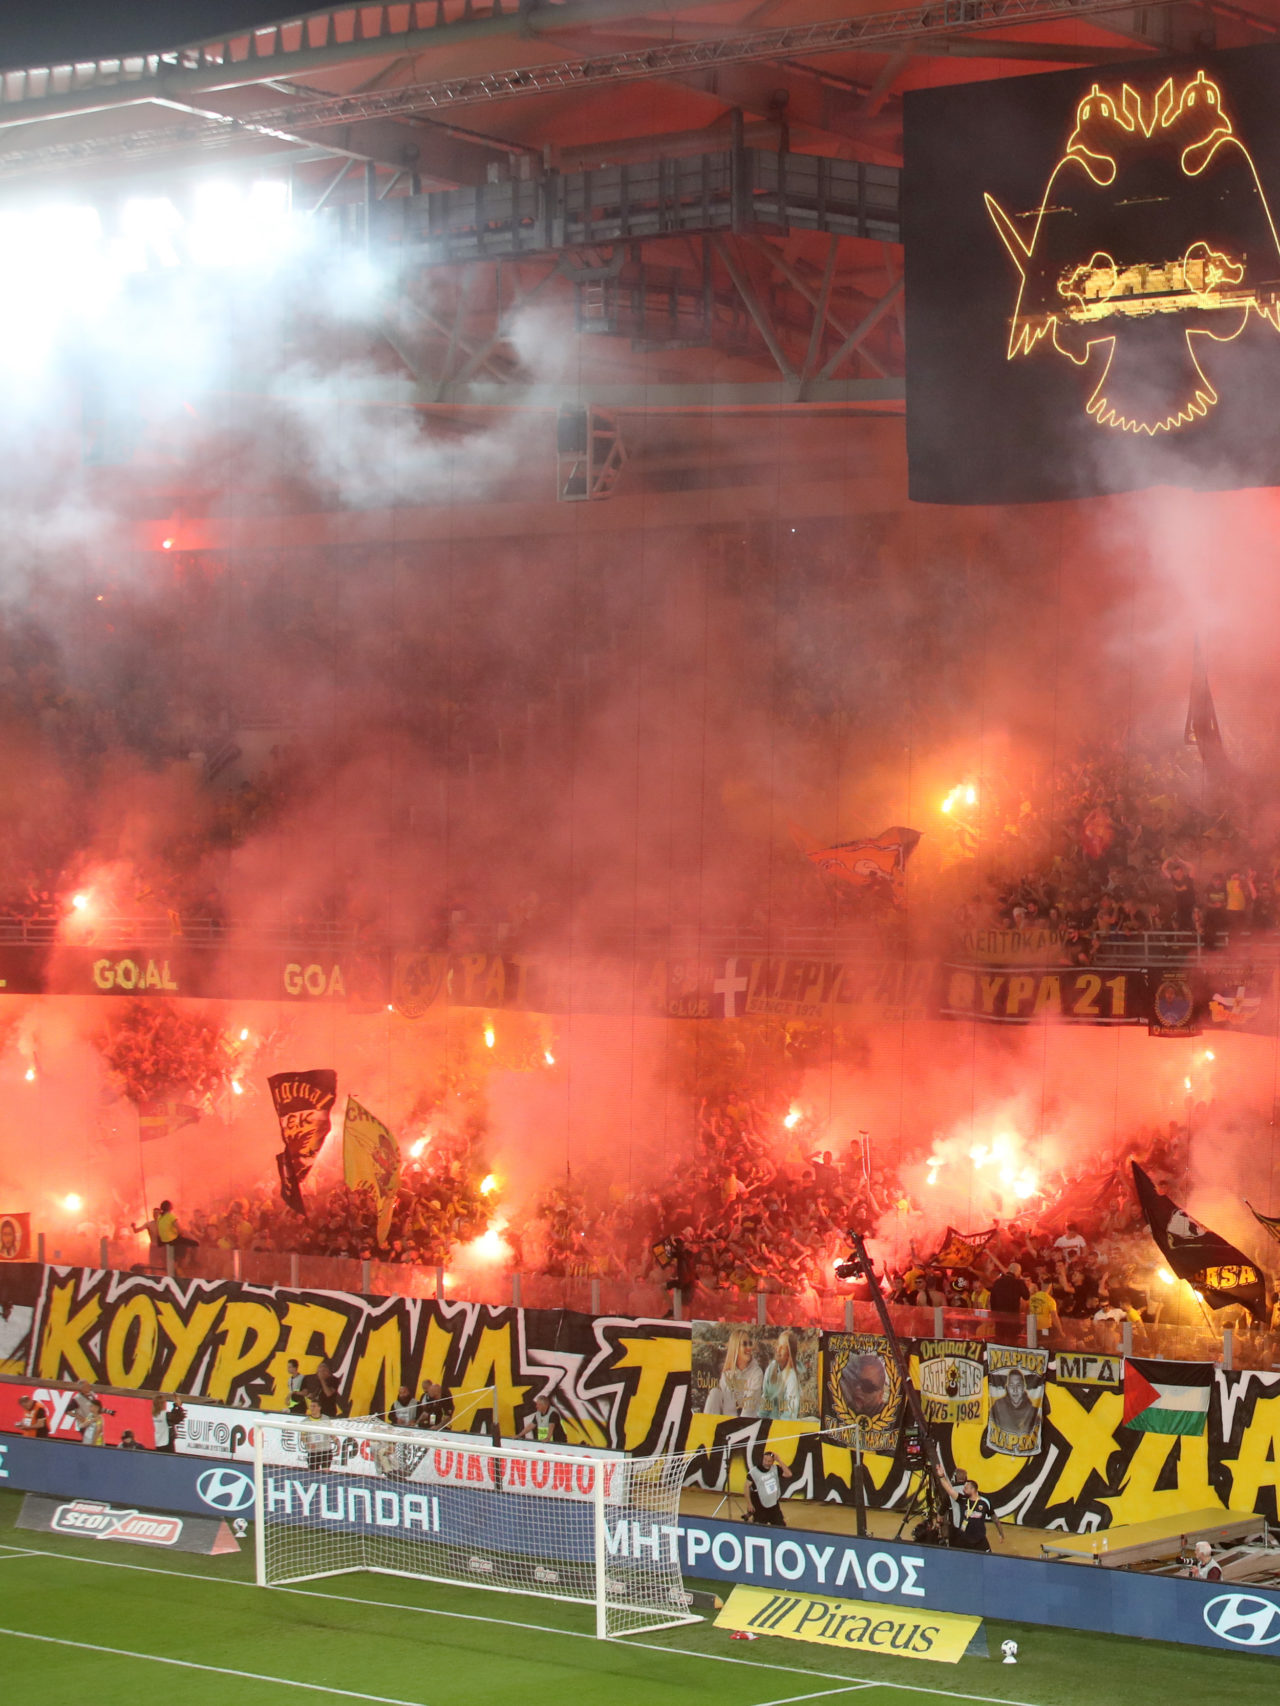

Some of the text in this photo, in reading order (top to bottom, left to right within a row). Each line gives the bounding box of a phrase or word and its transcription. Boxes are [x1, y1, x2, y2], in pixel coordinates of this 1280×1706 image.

[93, 958, 178, 990] GOAL
[284, 964, 346, 995] GOA
[1073, 974, 1126, 1016] 21
[920, 1340, 982, 1360] Original 21
[1060, 1356, 1116, 1382] ΜΓΔ
[956, 1400, 981, 1421] 1982
[266, 1478, 441, 1532] HYUNDAI
[603, 1515, 926, 1597] ΜΗΤΡΟΠΟΥΛΟΣ
[799, 1600, 940, 1653] Piraeus
